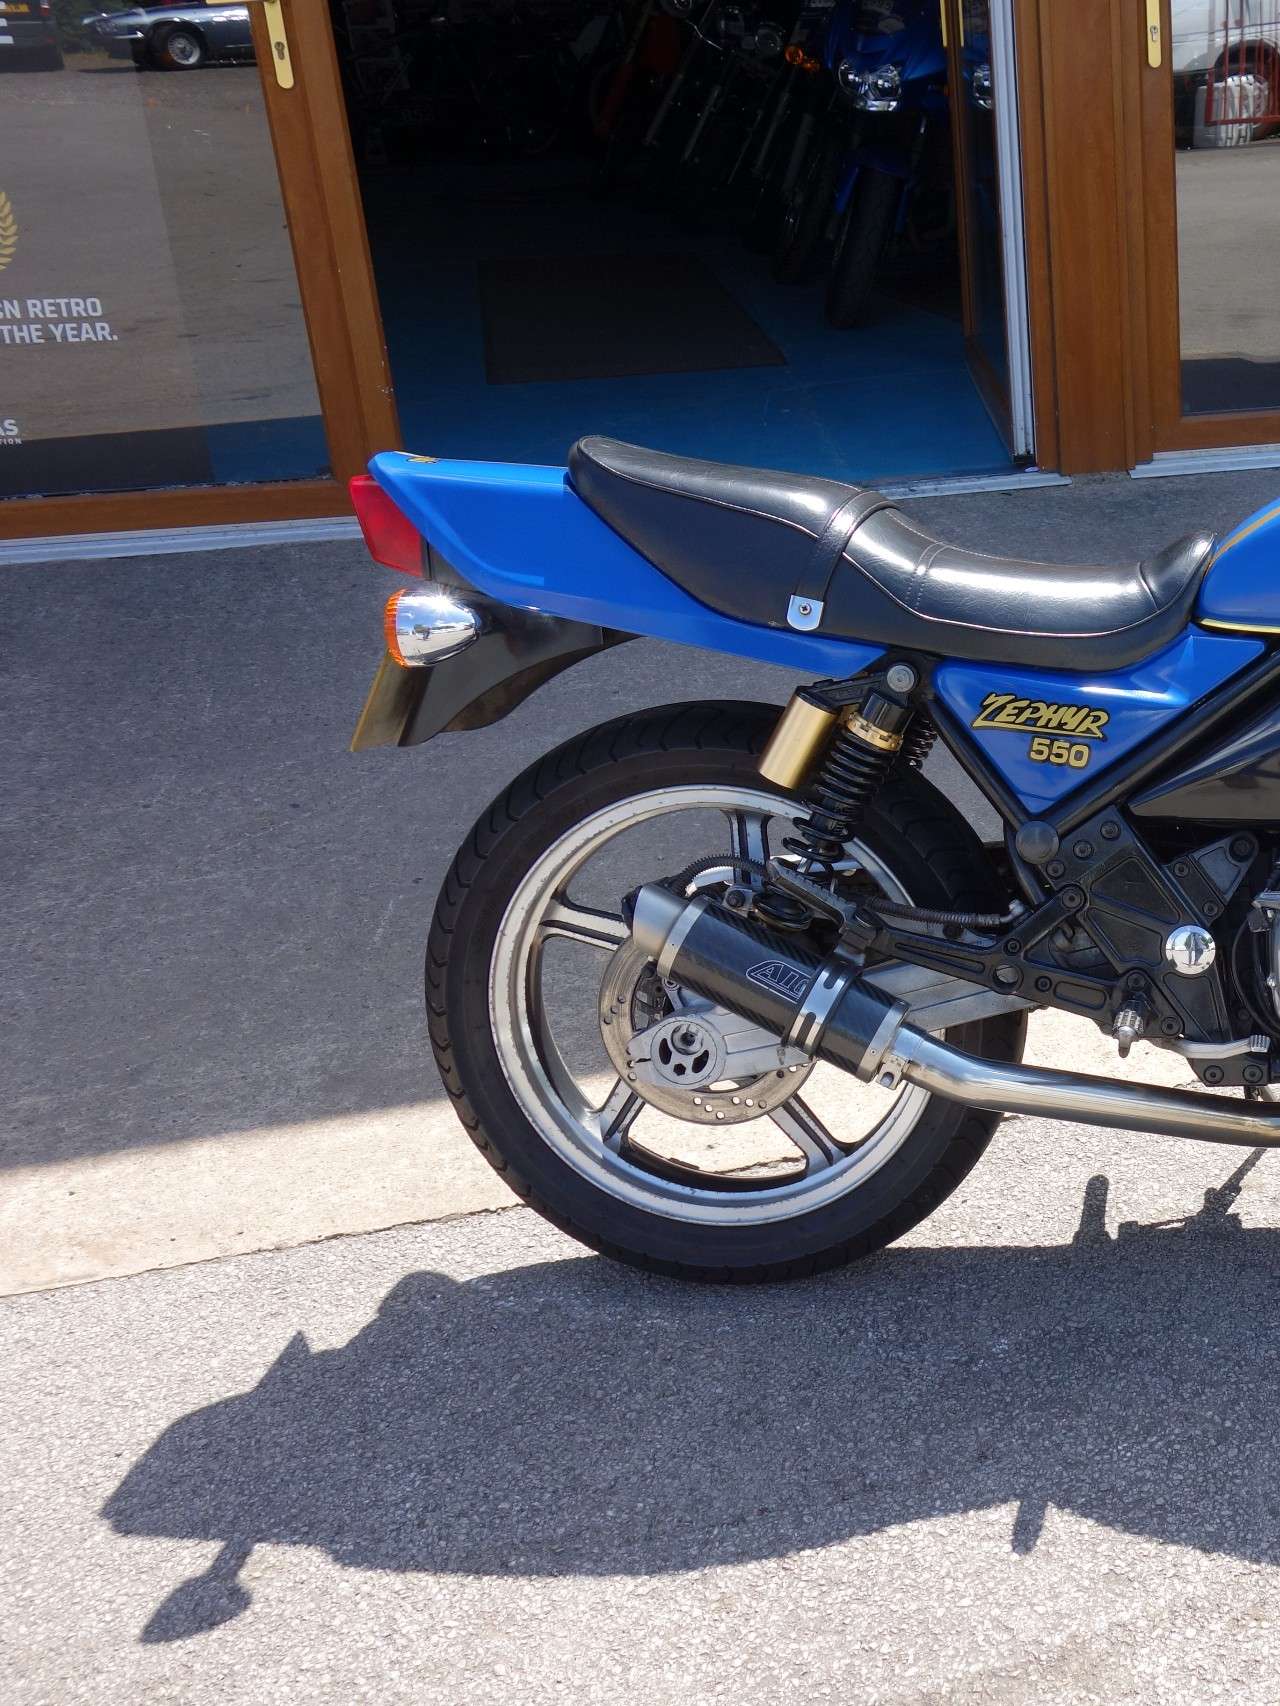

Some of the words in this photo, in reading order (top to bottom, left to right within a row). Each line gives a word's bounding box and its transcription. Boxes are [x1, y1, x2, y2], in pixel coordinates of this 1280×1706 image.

[0, 299, 21, 319] N
[26, 297, 103, 318] RETRO
[0, 323, 45, 344] THE
[48, 322, 118, 342] YEAR.
[972, 692, 1110, 739] ZEPHYR
[1029, 736, 1090, 768] 550
